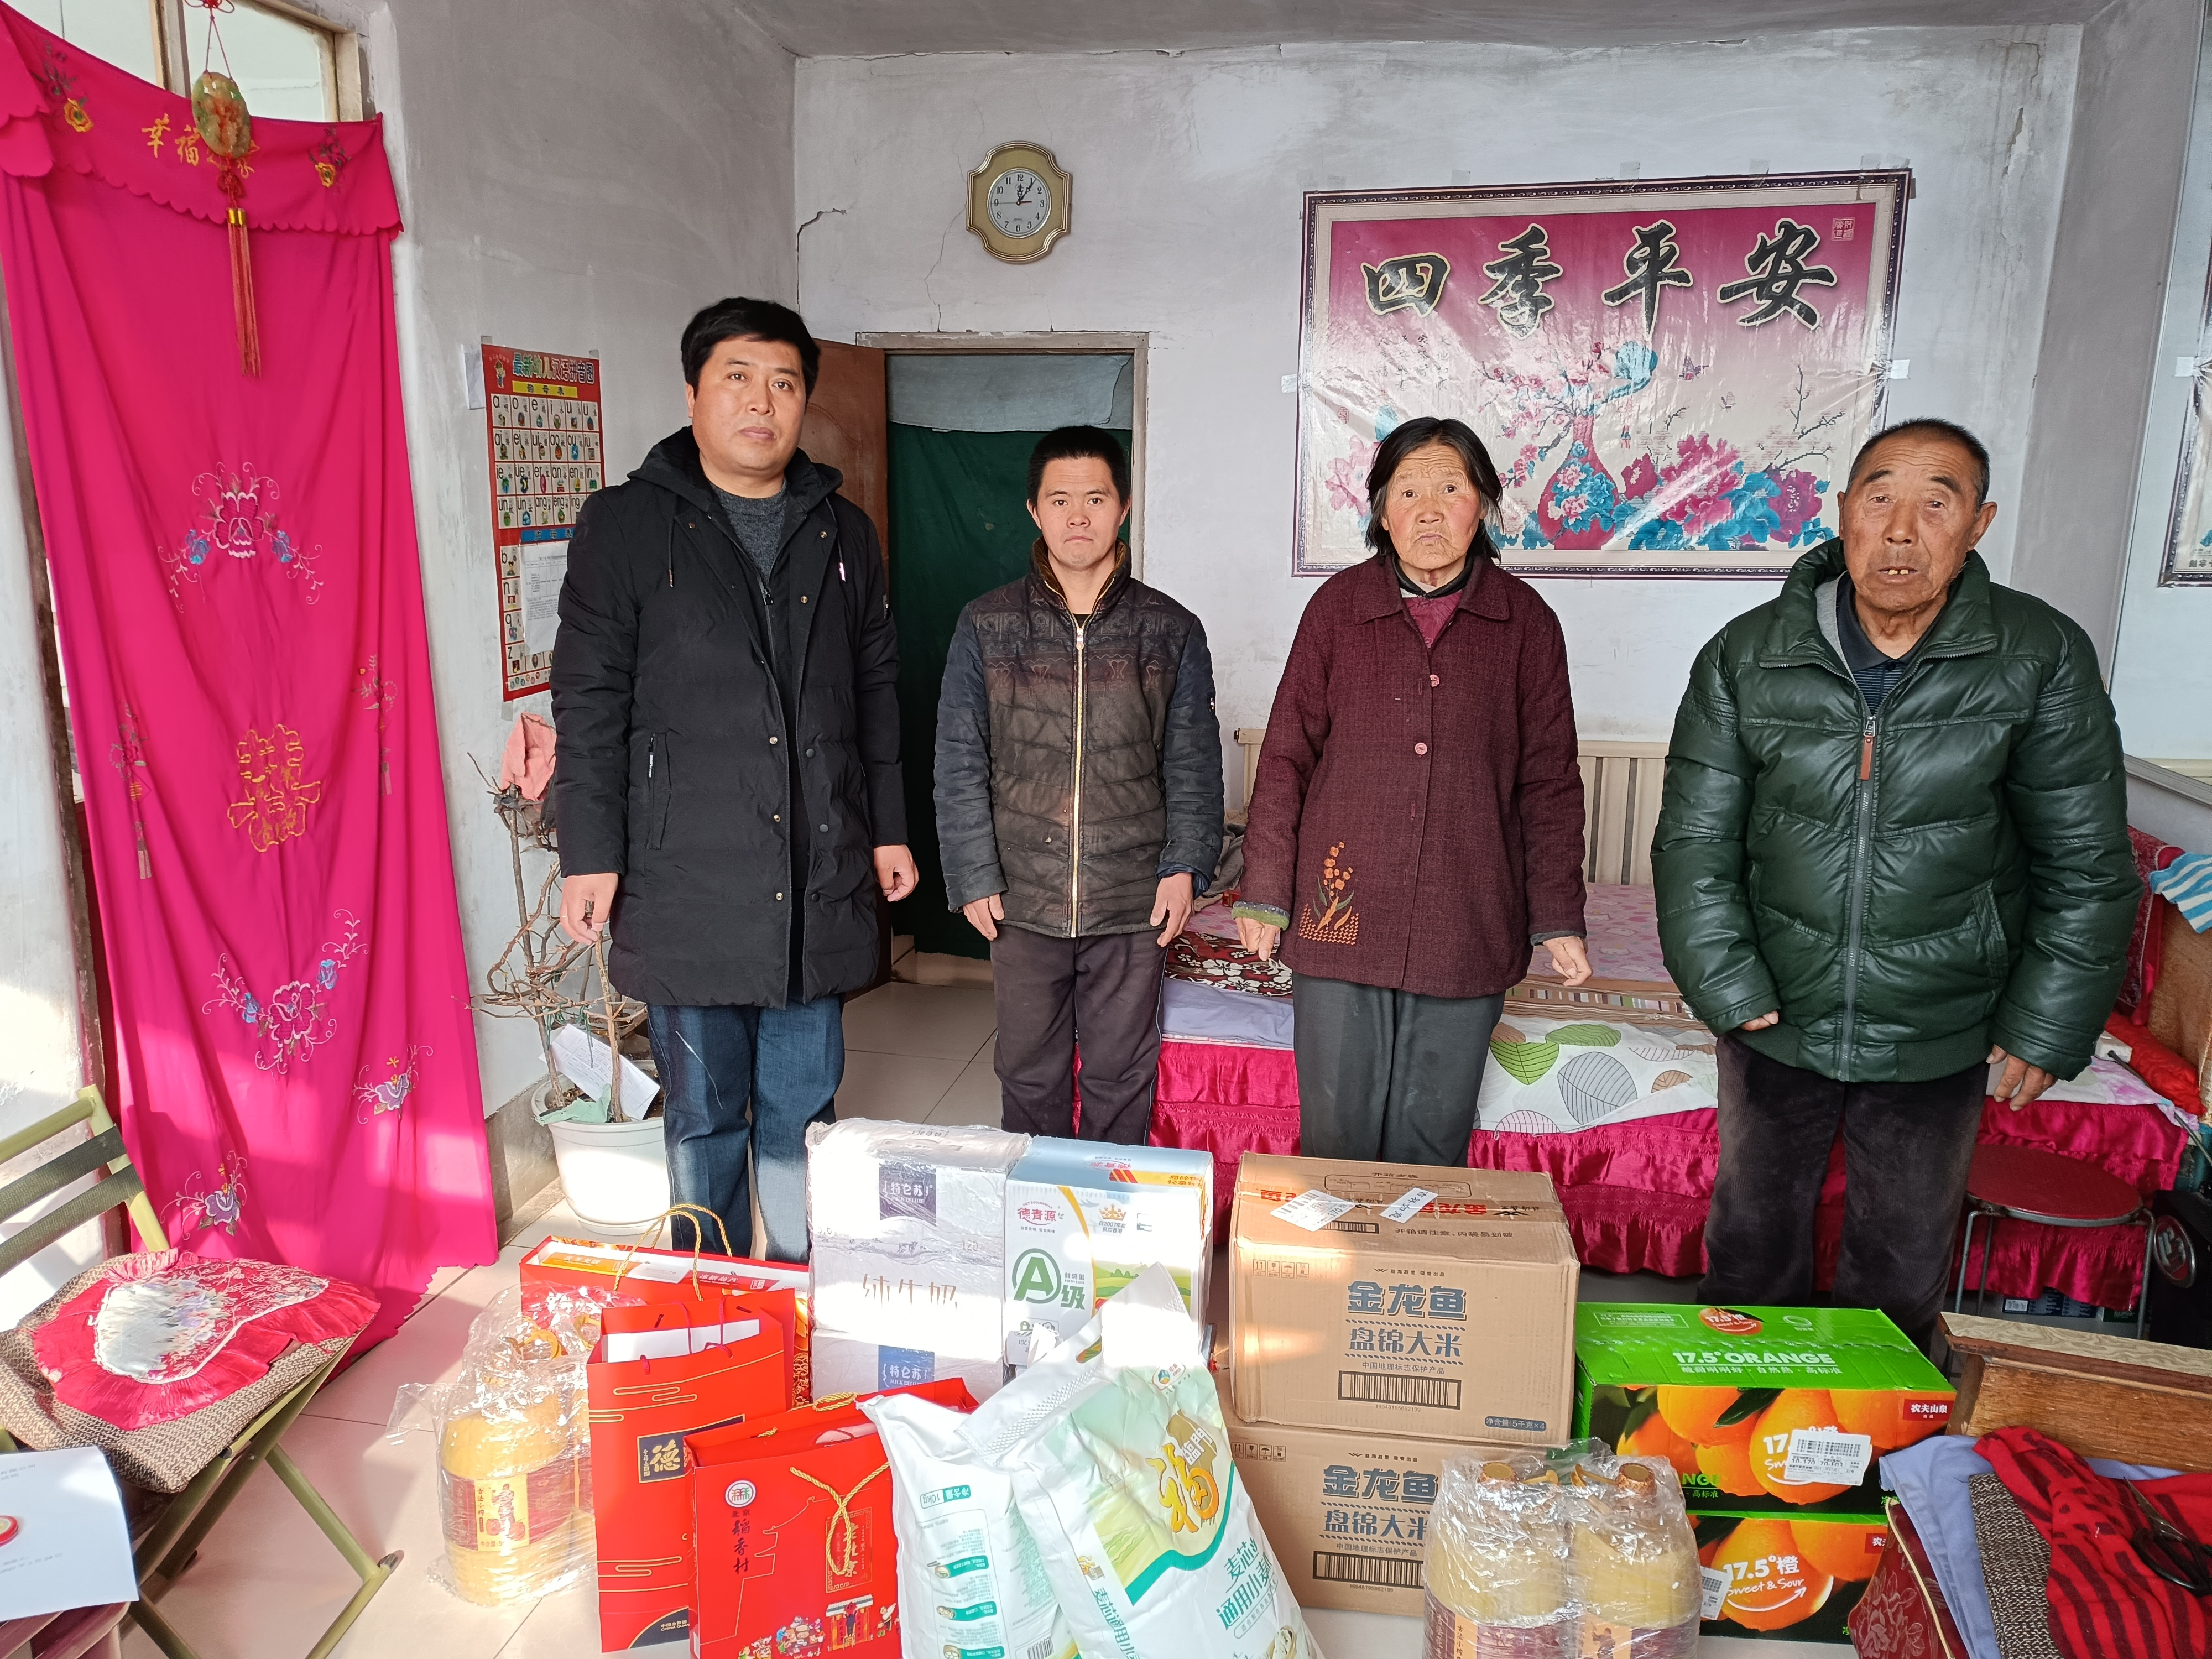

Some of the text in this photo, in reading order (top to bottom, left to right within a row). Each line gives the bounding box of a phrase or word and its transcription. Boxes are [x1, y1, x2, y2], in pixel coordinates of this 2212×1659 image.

[1360, 218, 1837, 340] 四季平安
[513, 352, 595, 384] 最新幼儿汉语拼音图
[493, 395, 500, 408] a
[512, 397, 519, 409] o
[531, 399, 538, 411] e
[566, 401, 572, 414] u
[494, 430, 503, 446] ai
[514, 430, 521, 445] ei
[532, 431, 539, 446] ui
[550, 434, 560, 446] ao
[568, 435, 576, 445] ou
[496, 464, 504, 479] ie
[534, 467, 542, 477] er
[552, 467, 561, 478] an
[570, 467, 578, 478] en
[586, 465, 592, 478] in
[498, 499, 508, 511] un
[536, 497, 547, 510] ang
[554, 497, 565, 509] eng
[571, 496, 580, 509] ing
[501, 550, 508, 564] b
[503, 582, 510, 595] n
[505, 614, 512, 627] q
[891, 1182, 924, 1196] 特仑苏
[1017, 1207, 1056, 1222] 德青源
[1065, 1272, 1085, 1281] 鲜鸡蛋
[1348, 1281, 1467, 1321] 金龙鱼
[1349, 1327, 1462, 1357] 盘锦大米
[890, 1365, 922, 1380] 特仑苏
[1362, 1361, 1445, 1375] 中国地理标志保护产品
[1911, 1404, 1948, 1414] 农夫山泉
[650, 1439, 681, 1472] 德
[1323, 1465, 1438, 1505] 金龙鱼
[1682, 1473, 1720, 1486] NGE
[923, 1487, 969, 1504] 净含量 10kg
[1145, 1443, 1219, 1533] 福
[1693, 1490, 1719, 1498] 高标准
[731, 1509, 750, 1518] 北京
[1324, 1509, 1428, 1540] 盘锦大米
[732, 1519, 750, 1575] 稻香村
[1337, 1543, 1417, 1557] 中国地理标志保护产品
[1723, 1555, 1800, 1581] 17.5°橙
[1727, 1578, 1805, 1597] Sweet & Sour
